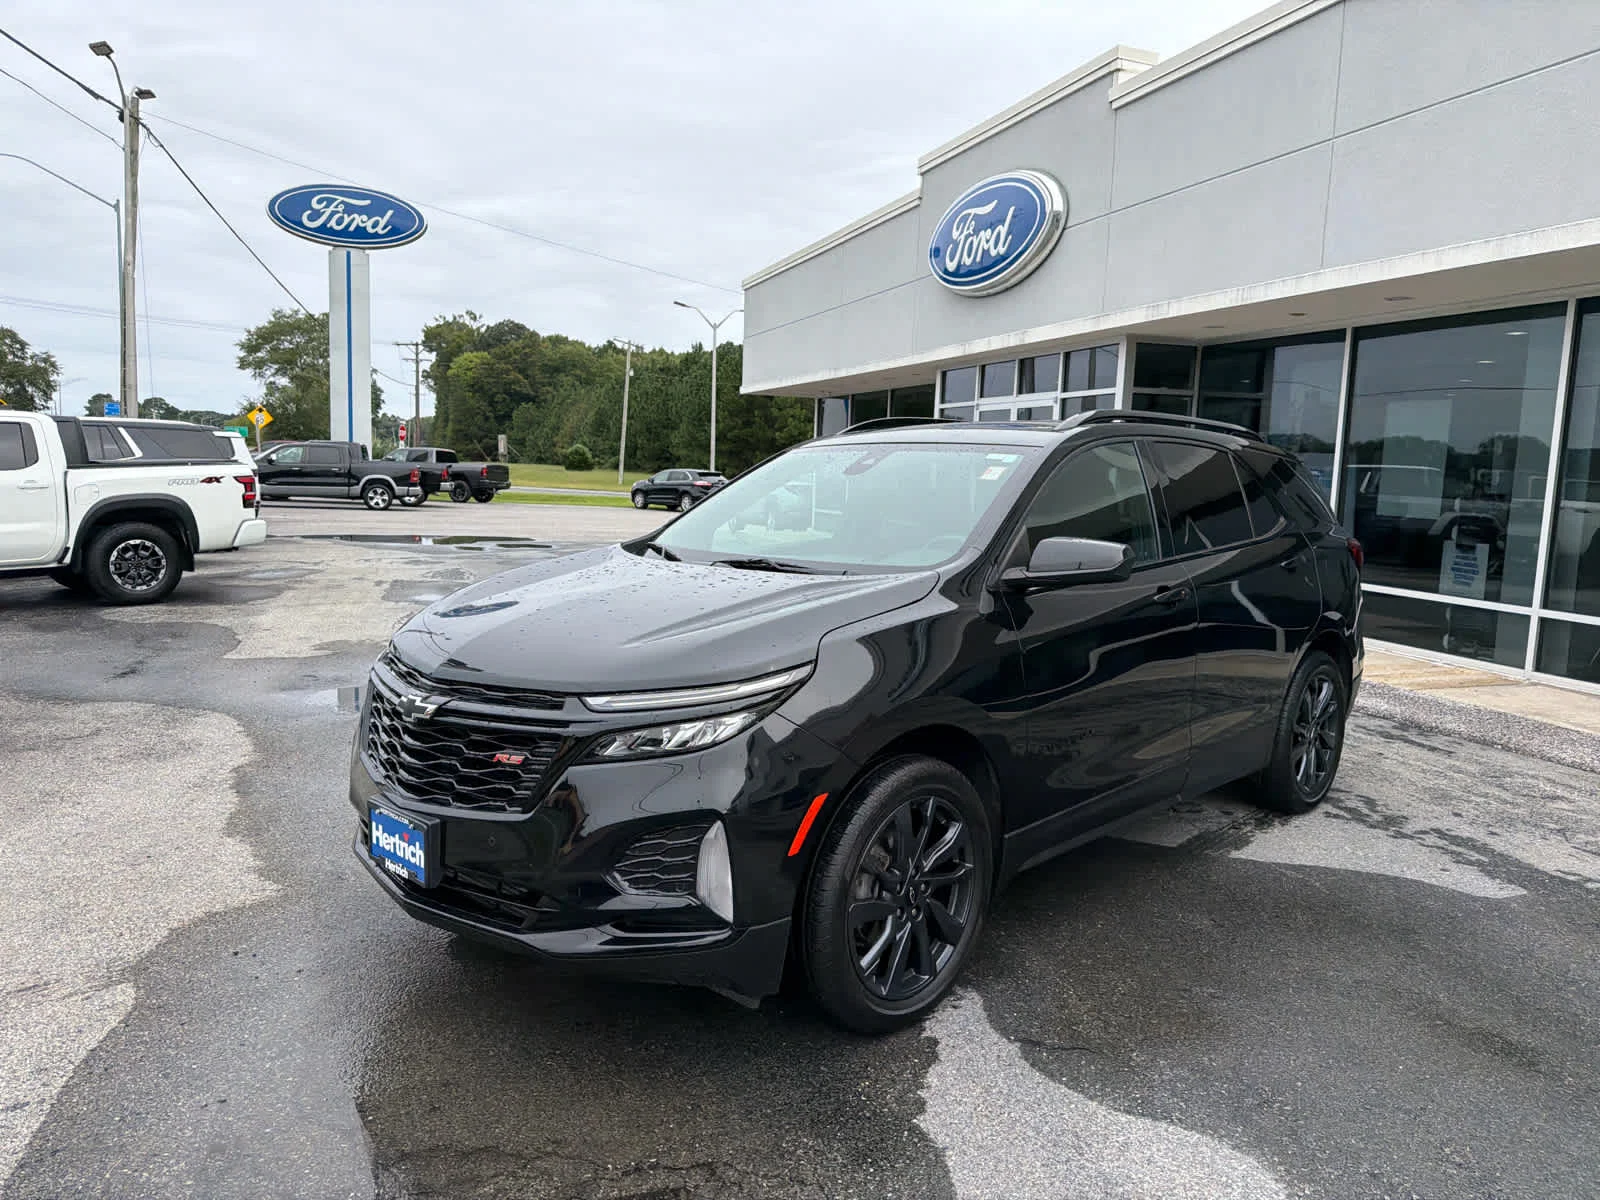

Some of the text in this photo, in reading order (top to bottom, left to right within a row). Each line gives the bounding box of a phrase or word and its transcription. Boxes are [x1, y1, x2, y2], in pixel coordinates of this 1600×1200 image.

[302, 194, 394, 234] Ford
[945, 200, 1015, 272] Ford
[492, 753, 525, 764] RS
[372, 821, 424, 868] Hertrich
[385, 858, 409, 879] Hertrich
